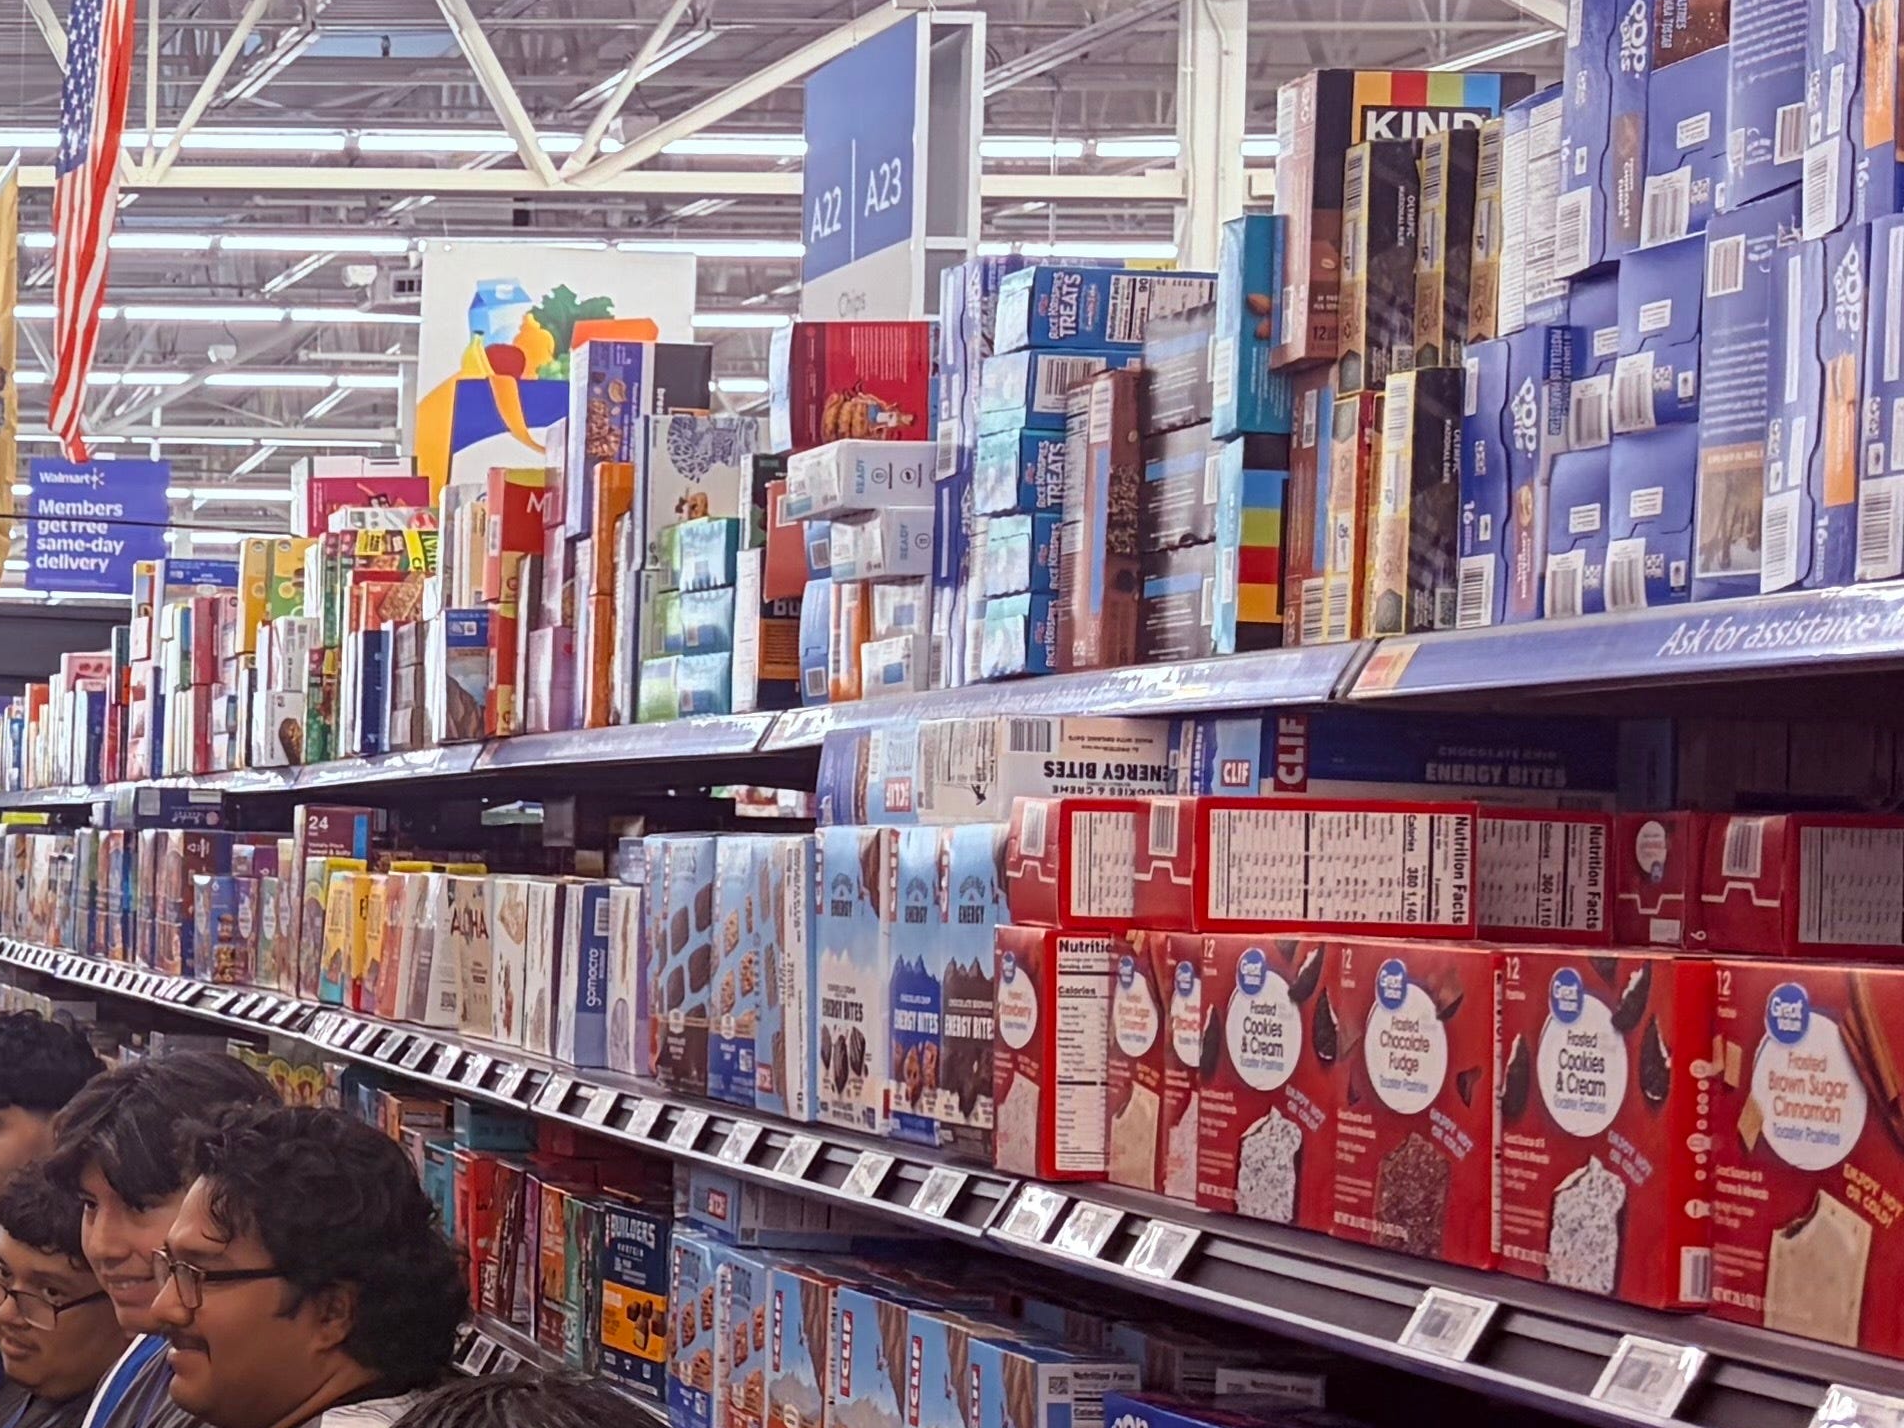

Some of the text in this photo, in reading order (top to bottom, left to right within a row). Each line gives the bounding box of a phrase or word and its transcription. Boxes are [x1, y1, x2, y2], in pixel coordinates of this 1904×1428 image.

[810, 156, 902, 241] A22 A23
[1060, 273, 1081, 341] TREATS
[39, 471, 89, 485] Walmart
[38, 499, 123, 516] Members
[38, 520, 108, 537] get free
[36, 537, 124, 556] same-day
[36, 554, 108, 573] delivery
[1656, 610, 1878, 657] Ask for assistance
[1222, 761, 1251, 786] CLIF
[1452, 815, 1467, 925] Nutrition Facts
[586, 947, 599, 1006] gomacro
[1552, 978, 1580, 1001] Great
[1380, 1032, 1430, 1053] Chocolate
[1389, 1052, 1419, 1075] Fudge
[1557, 1048, 1606, 1074] Cookies
[1555, 1071, 1606, 1098] & Cream
[1768, 1071, 1849, 1101] Brown Sugar
[1773, 1099, 1841, 1124] Cinnamon
